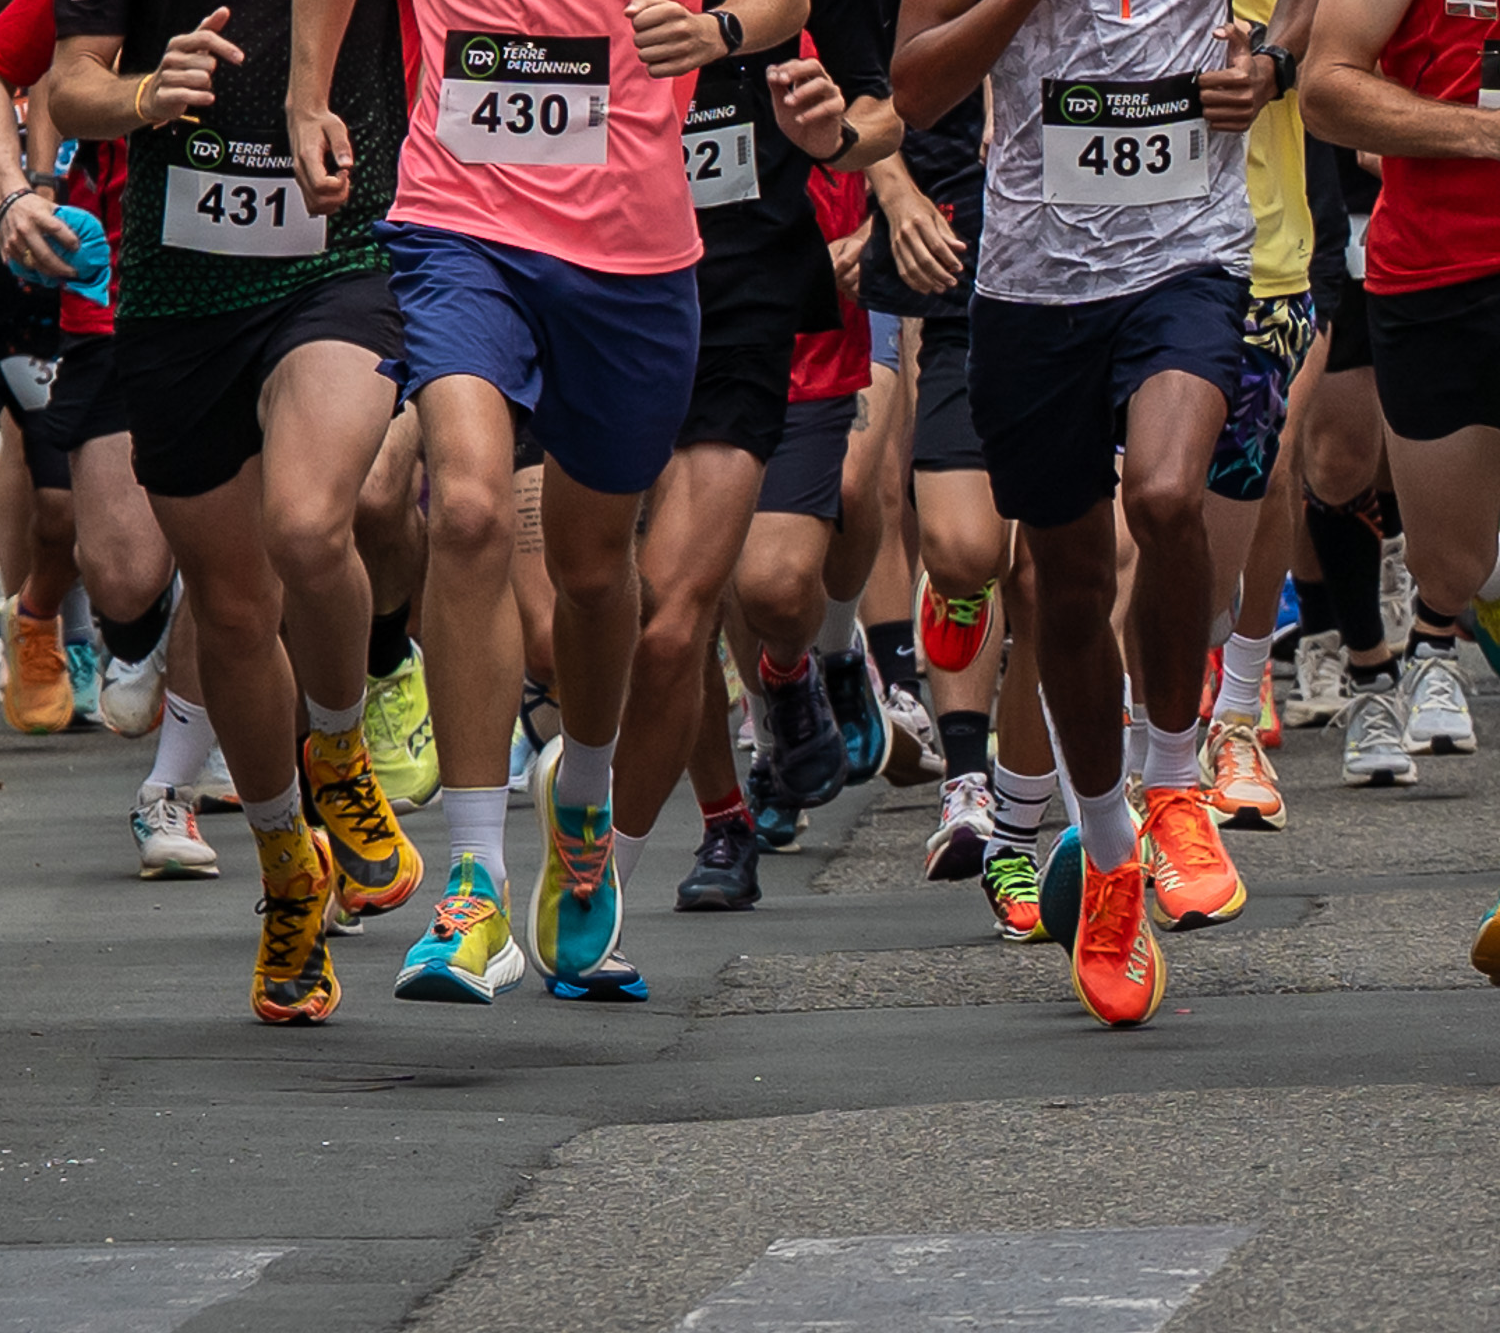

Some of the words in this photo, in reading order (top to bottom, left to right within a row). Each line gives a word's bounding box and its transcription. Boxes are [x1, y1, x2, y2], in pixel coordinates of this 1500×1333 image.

[468, 50, 494, 66] TDR
[503, 47, 547, 60] TERRE
[521, 61, 591, 75] RUNNING
[1067, 98, 1098, 113] TDR
[1106, 94, 1150, 107] TERRE
[1126, 99, 1190, 118] RUNNING
[471, 92, 569, 136] 430
[192, 141, 220, 158] TDR
[228, 141, 272, 155] TERRE
[1078, 134, 1172, 177] 483
[197, 183, 287, 227] 431
